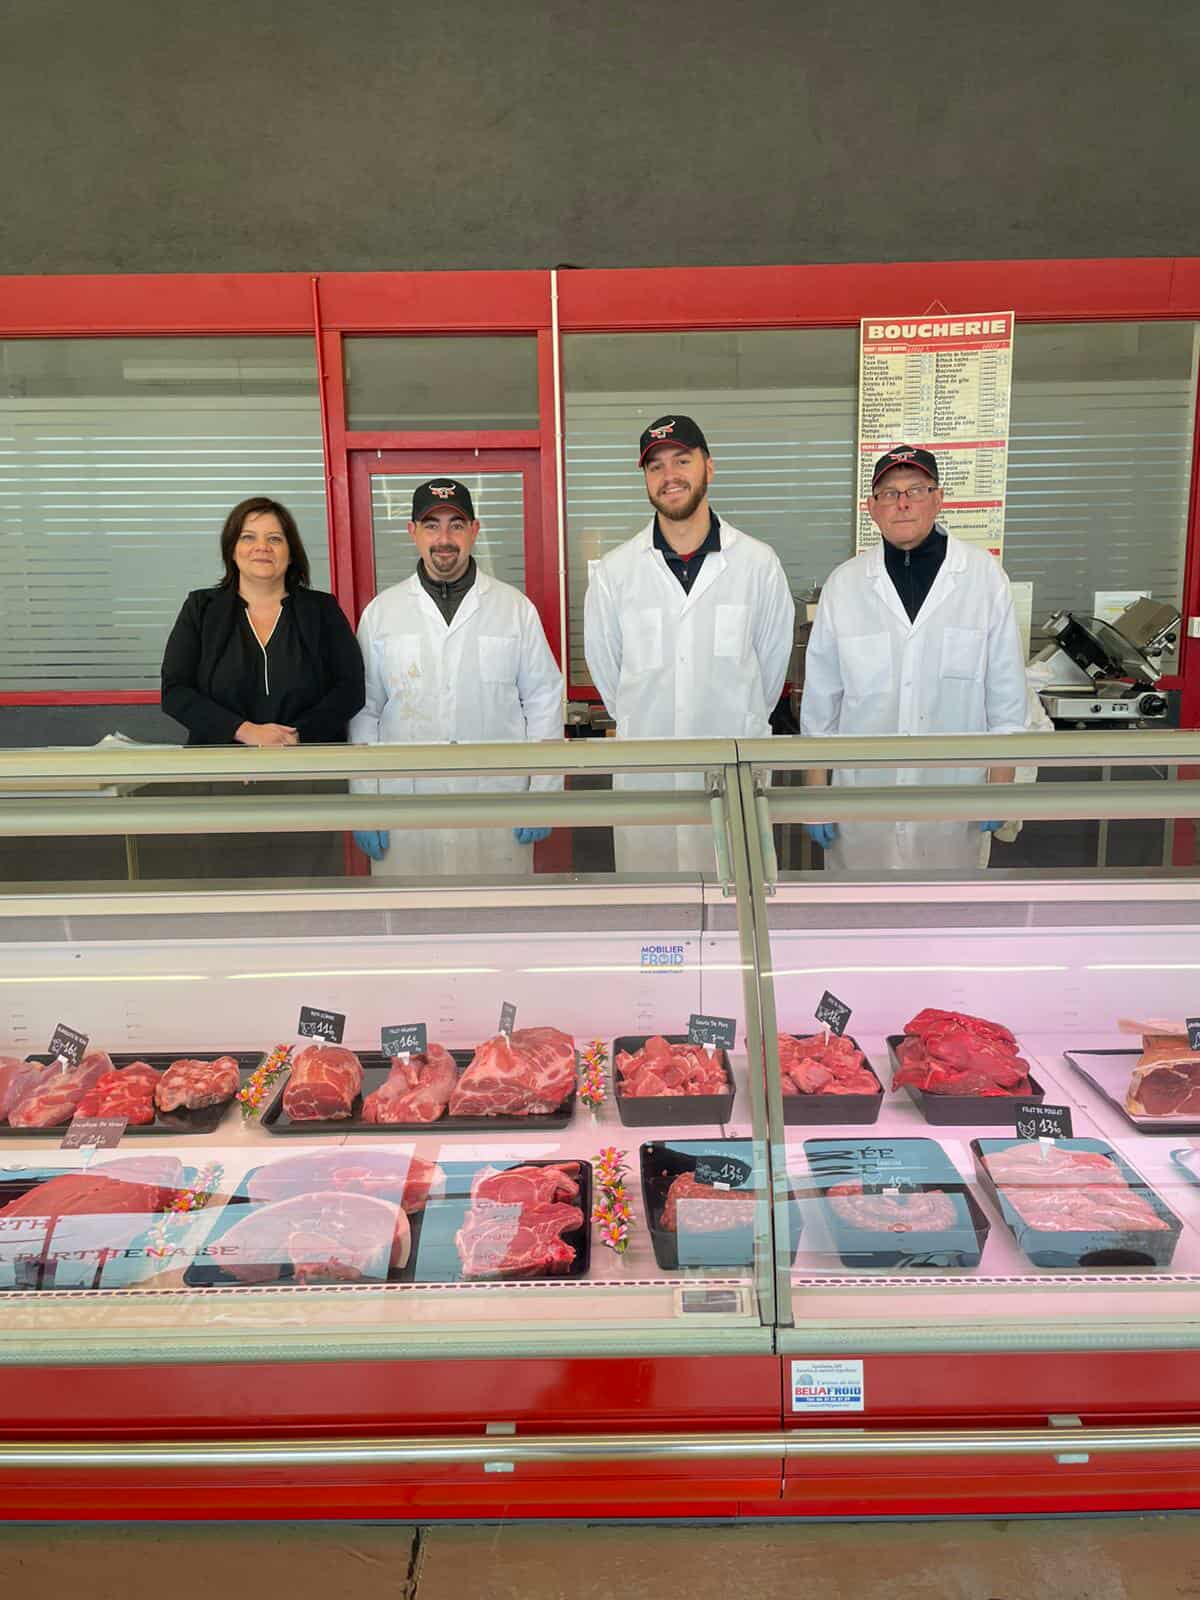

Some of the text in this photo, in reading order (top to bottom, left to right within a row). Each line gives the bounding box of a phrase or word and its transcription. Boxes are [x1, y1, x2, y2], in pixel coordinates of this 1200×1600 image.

[868, 320, 1006, 339] BOUCHERIE
[641, 945, 684, 954] MOBILIER
[641, 953, 684, 967] FROID
